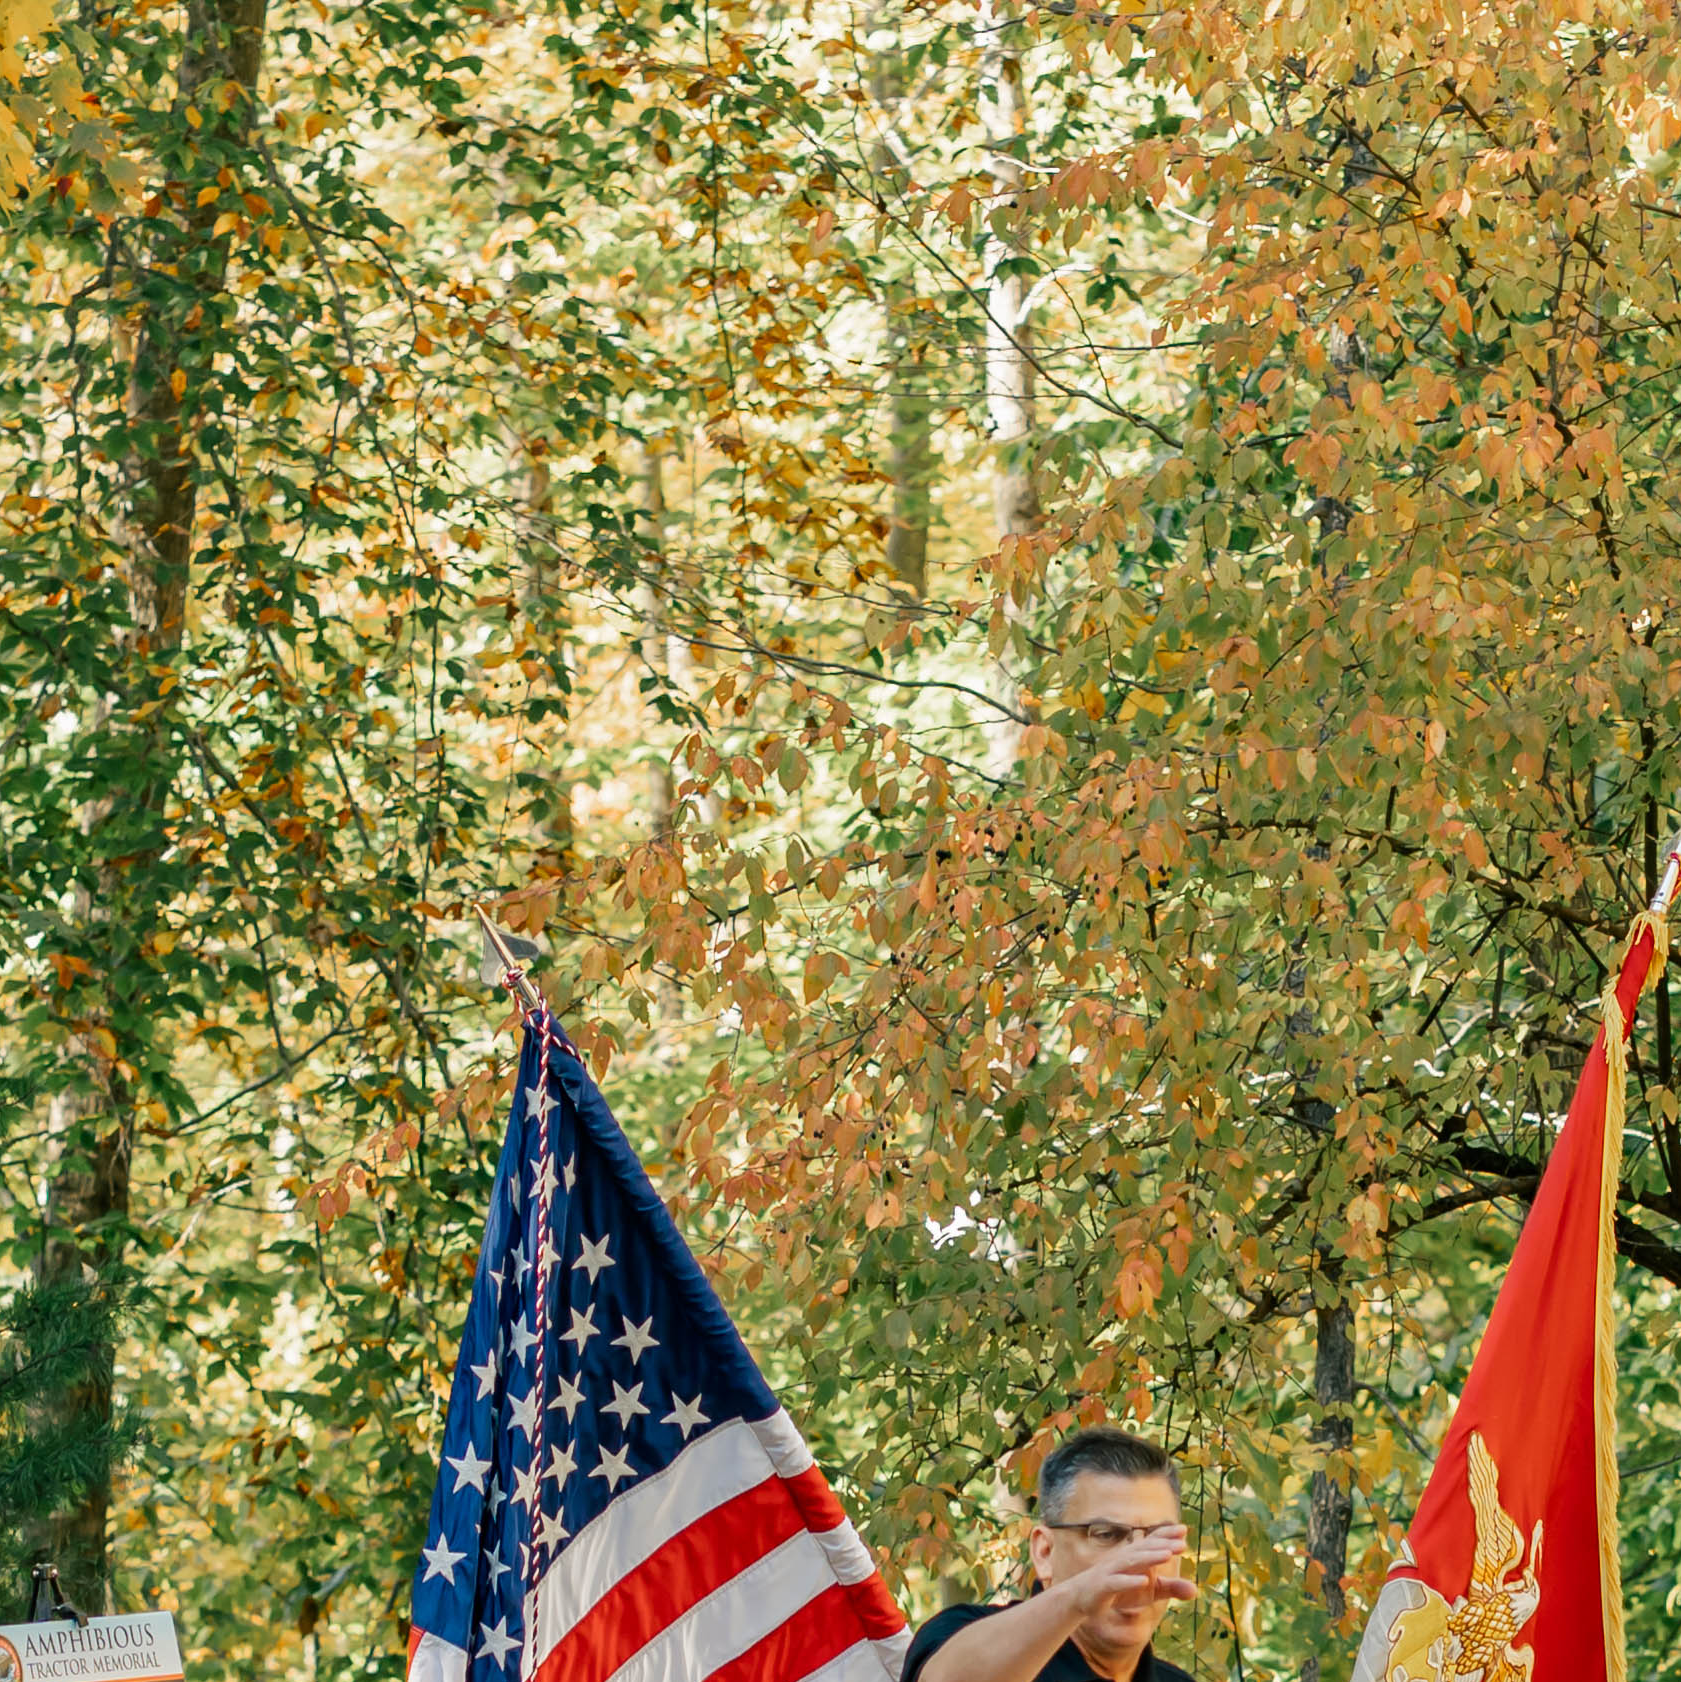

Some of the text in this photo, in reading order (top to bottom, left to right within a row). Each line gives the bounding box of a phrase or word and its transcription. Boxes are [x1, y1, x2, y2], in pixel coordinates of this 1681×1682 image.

[24, 1623, 155, 1658] AMPHIBIOUS
[27, 1651, 162, 1680] TRACTOR MEMORIAL
